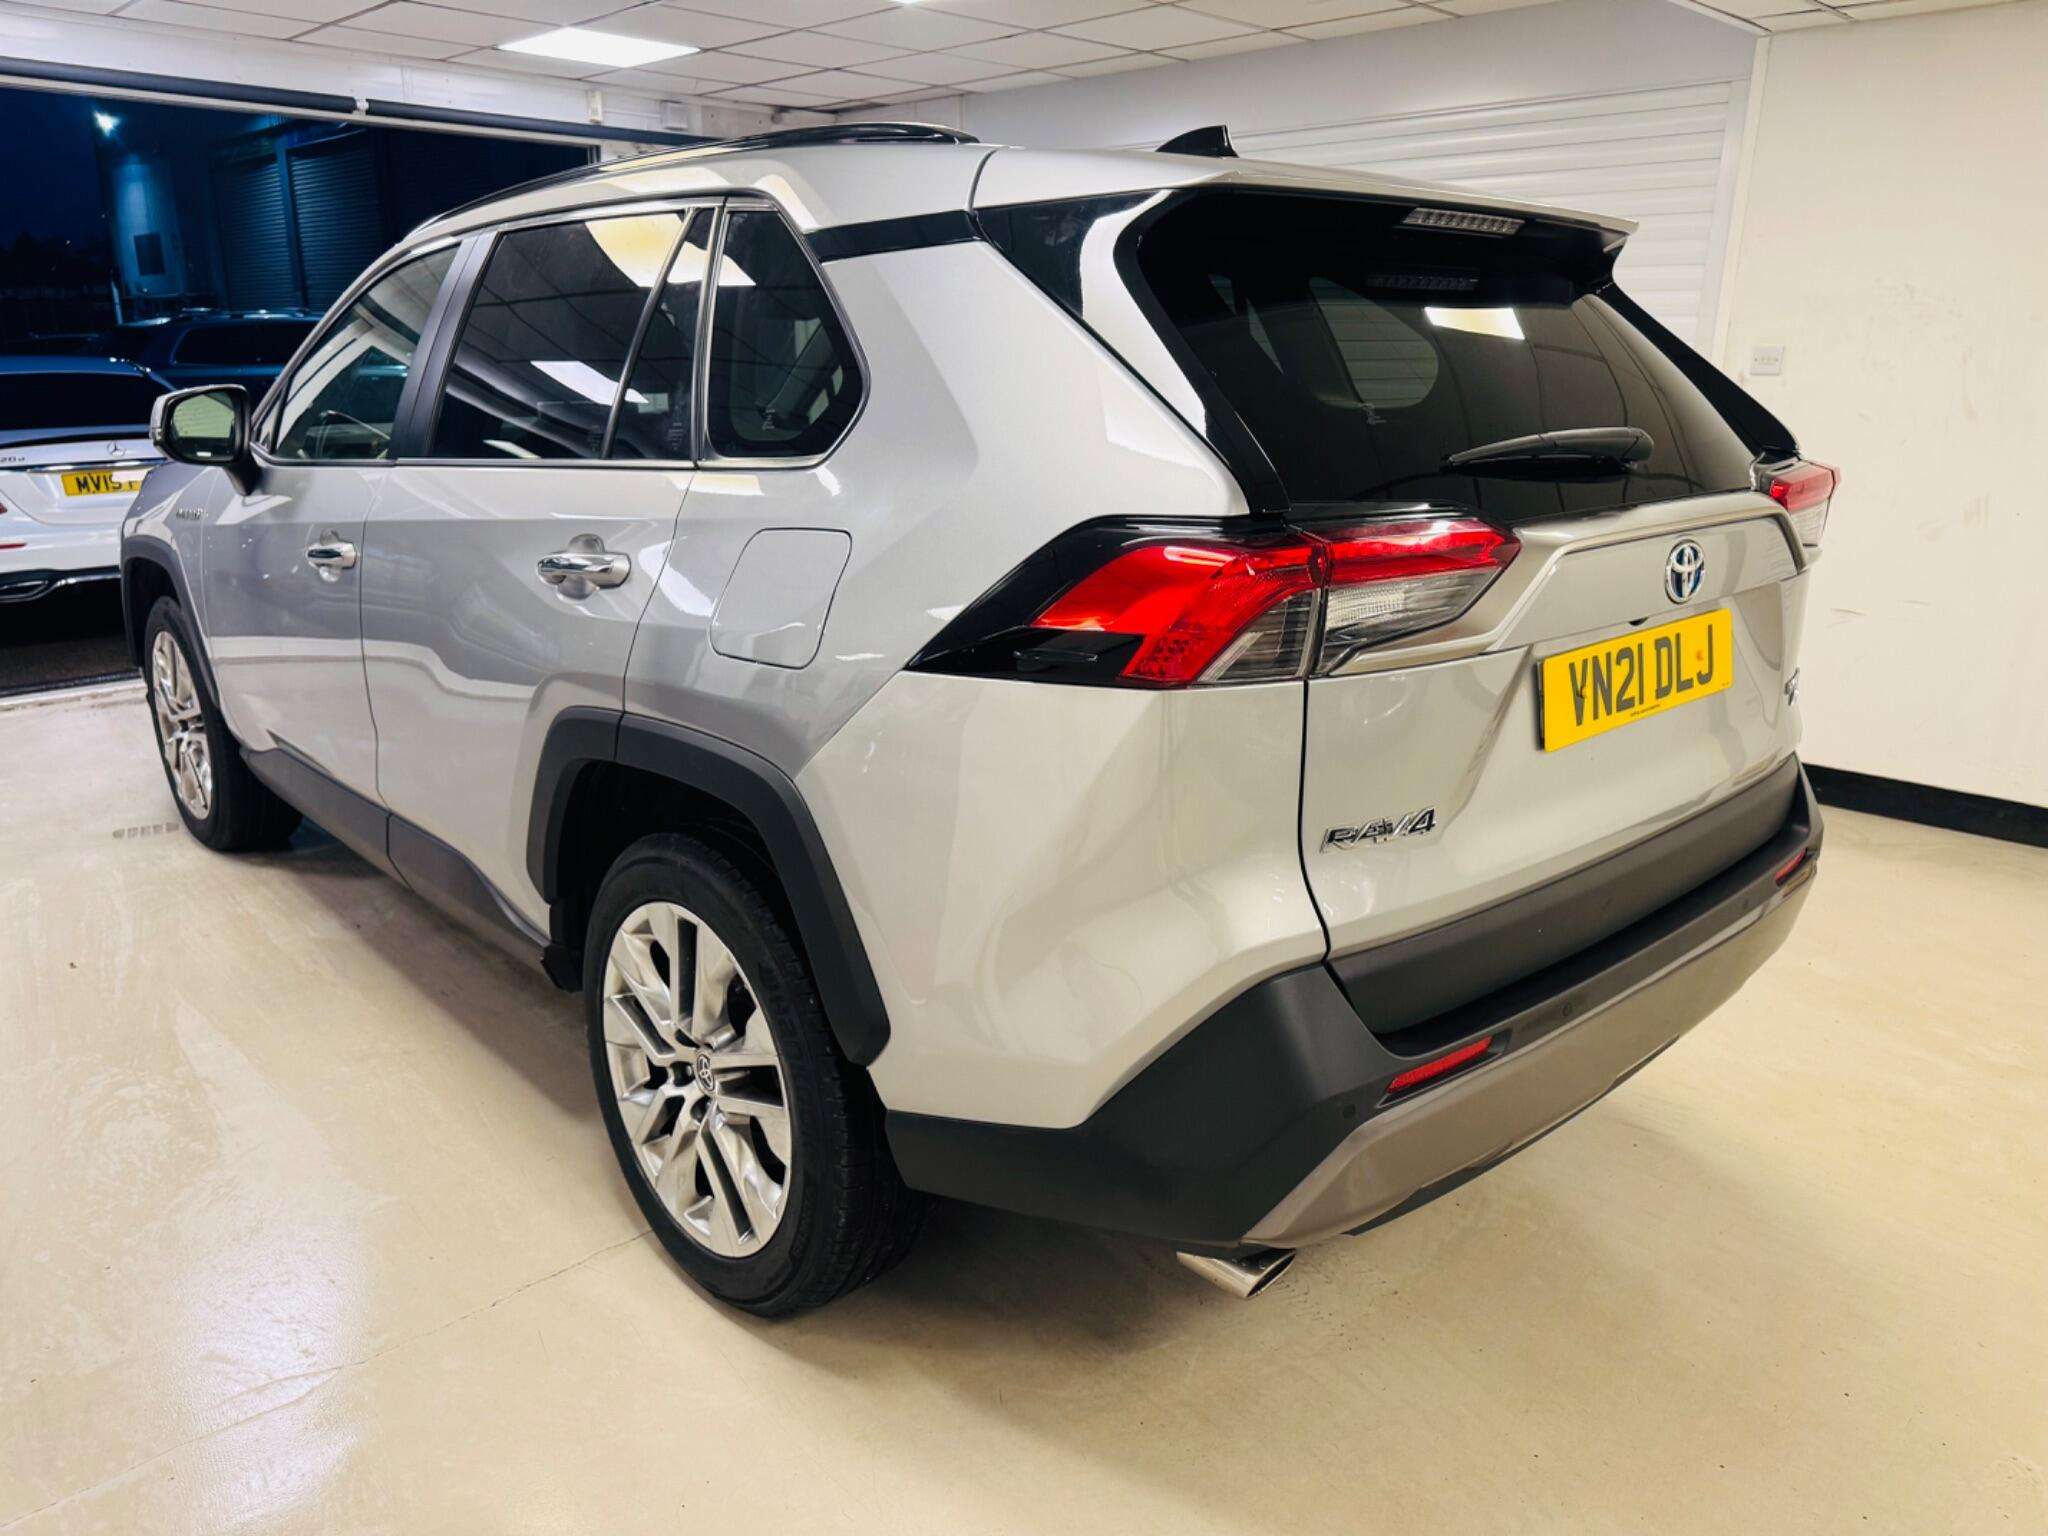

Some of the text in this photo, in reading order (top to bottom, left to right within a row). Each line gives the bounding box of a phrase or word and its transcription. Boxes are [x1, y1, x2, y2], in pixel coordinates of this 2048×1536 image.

[1569, 643, 1644, 726] VN21
[1654, 624, 1713, 699] DLJ
[1320, 806, 1437, 854] RAV4
